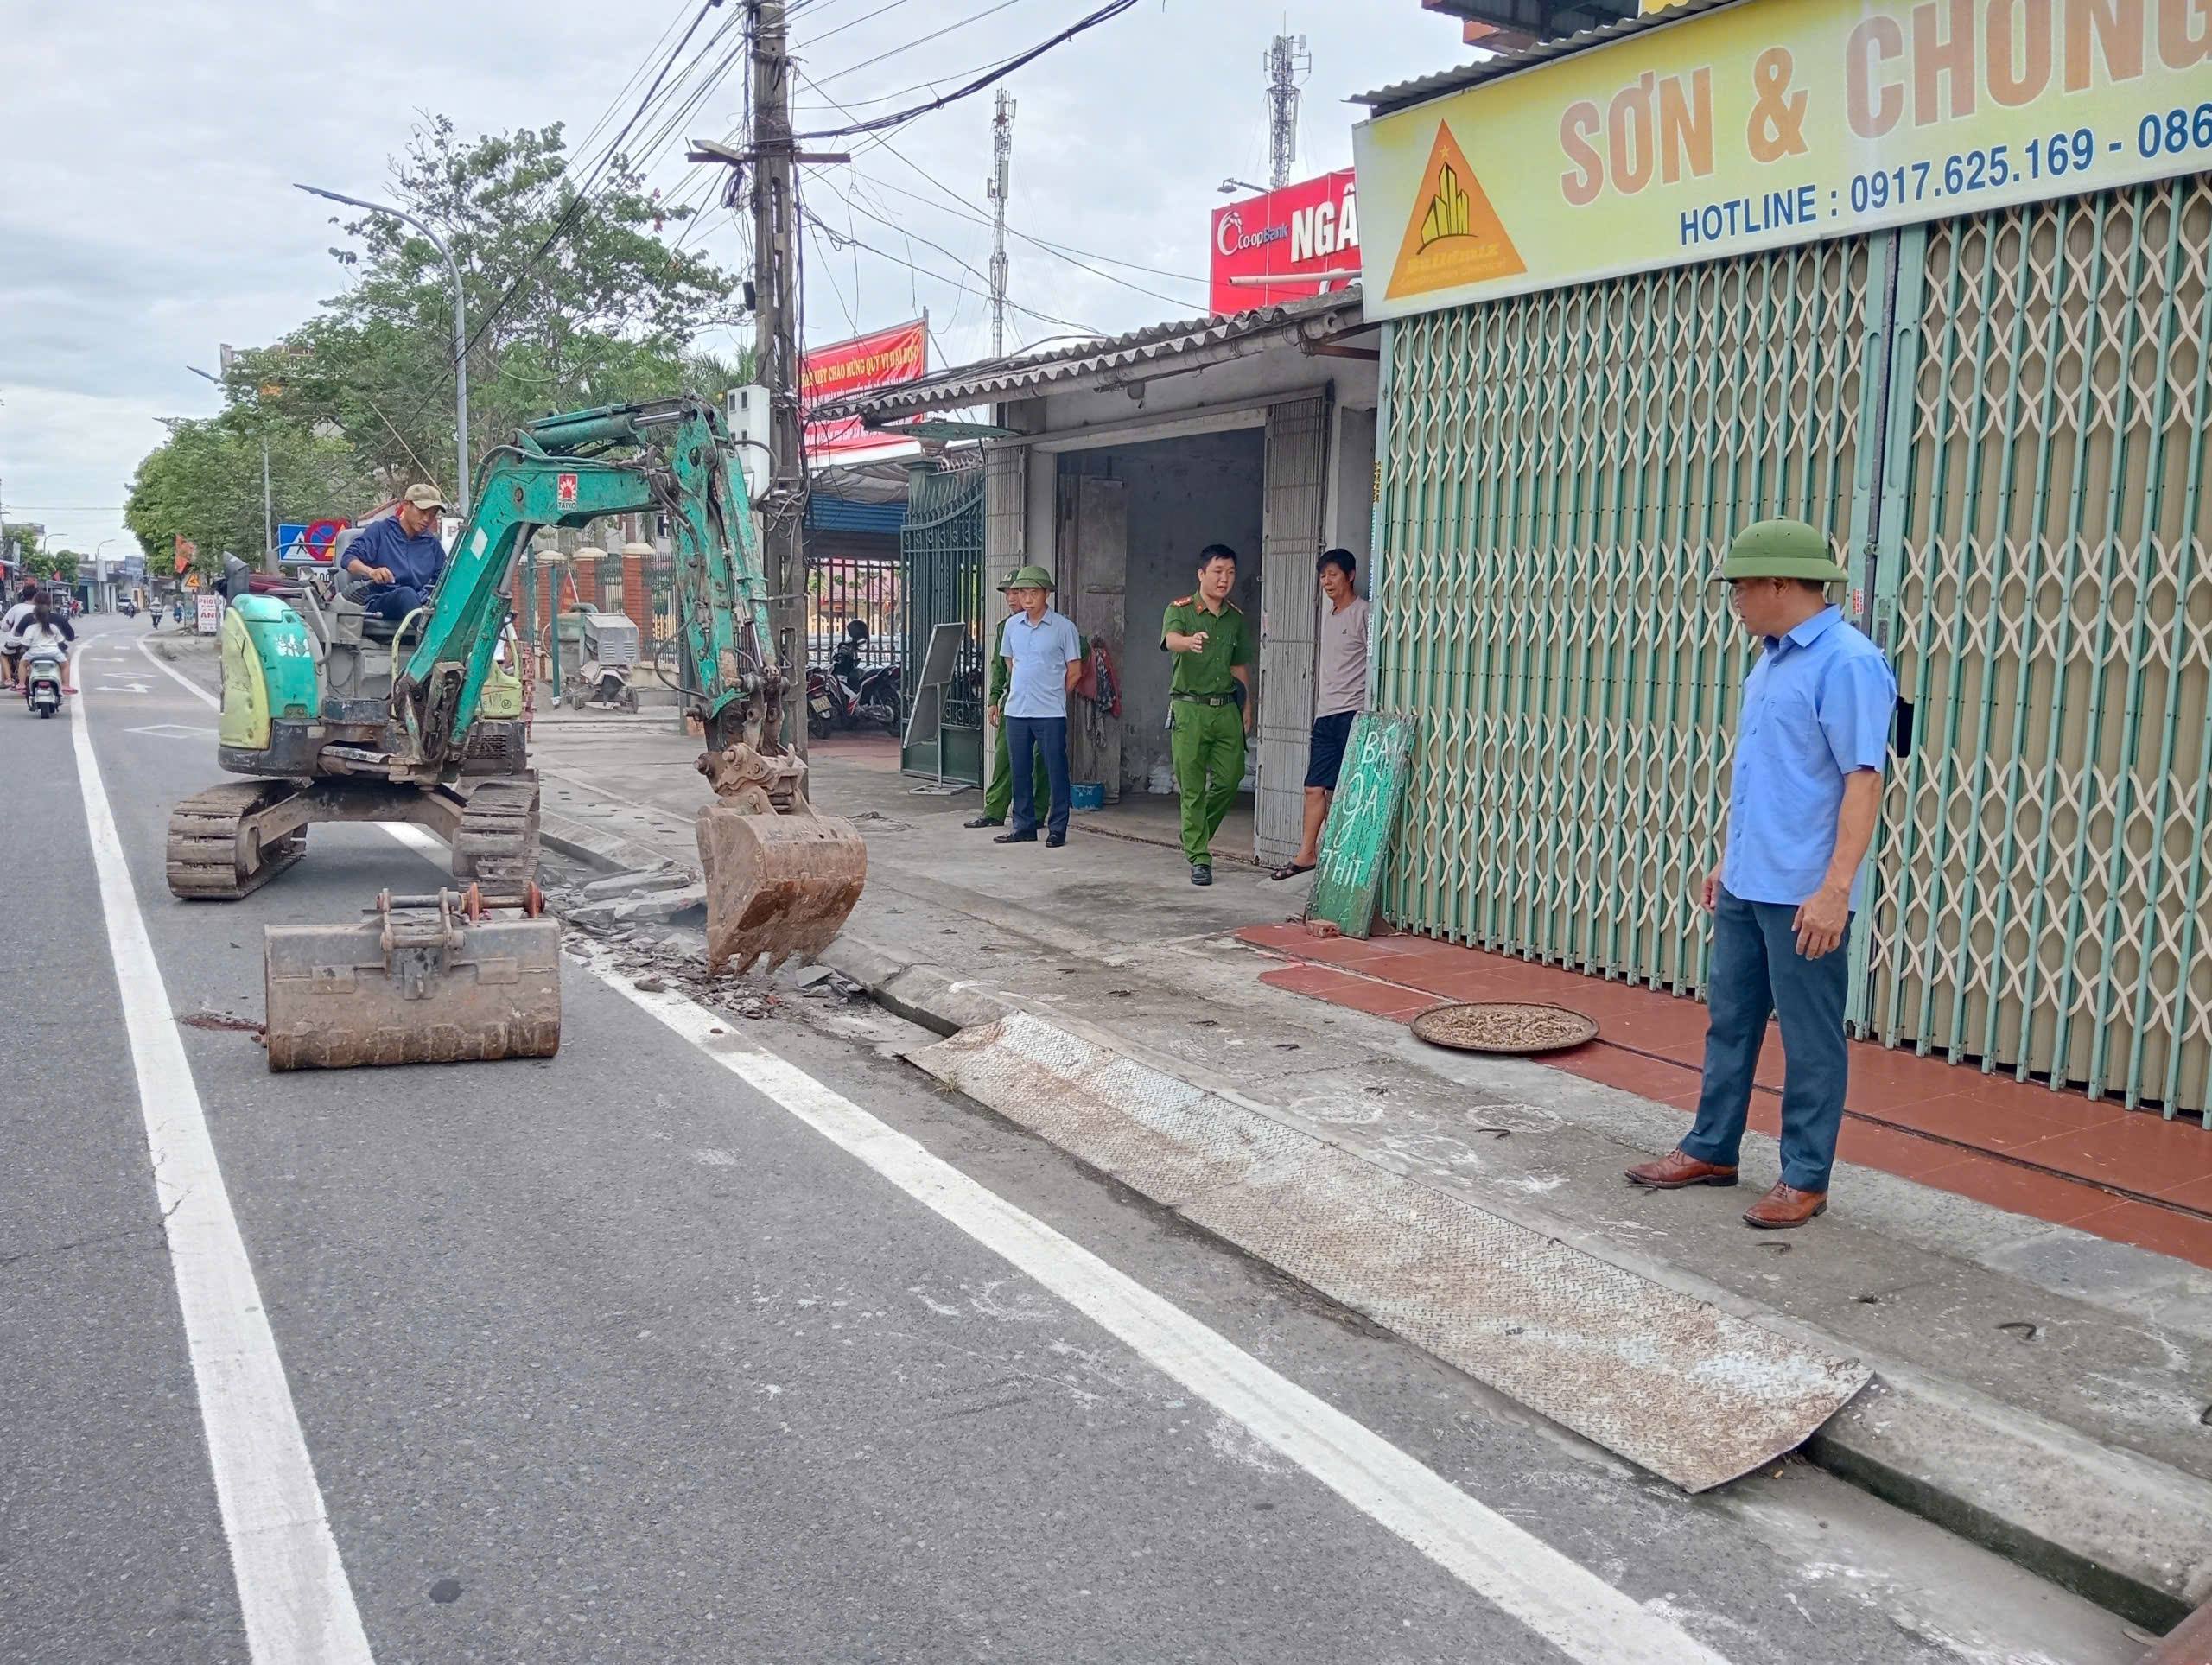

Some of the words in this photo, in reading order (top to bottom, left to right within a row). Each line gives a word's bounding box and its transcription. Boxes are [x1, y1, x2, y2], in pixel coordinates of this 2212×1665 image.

[1559, 66, 1714, 207] SƠN
[1746, 45, 1809, 164] &
[1680, 184, 1817, 245] HOTLINE
[1850, 127, 2094, 213] 0917.625.169
